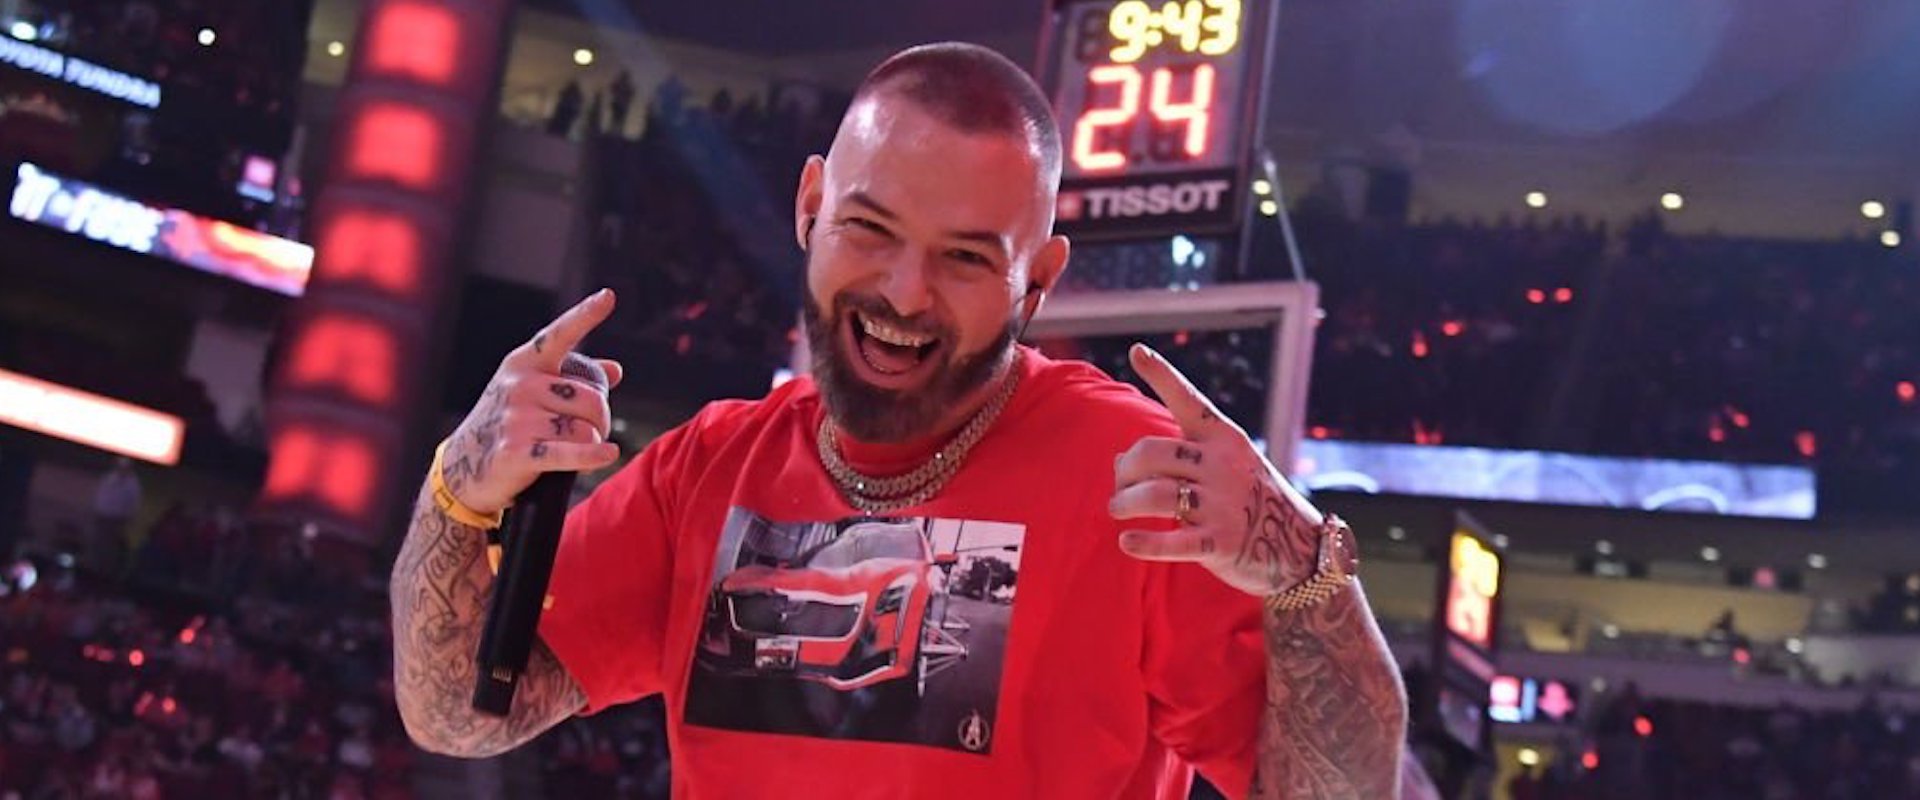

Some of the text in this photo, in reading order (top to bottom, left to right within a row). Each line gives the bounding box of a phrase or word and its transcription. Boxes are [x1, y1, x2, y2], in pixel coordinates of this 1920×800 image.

[1109, 0, 1241, 62] 9:43
[64, 56, 161, 108] TUNDRA
[1073, 64, 1214, 170] 24
[1086, 180, 1230, 219] TISSOT
